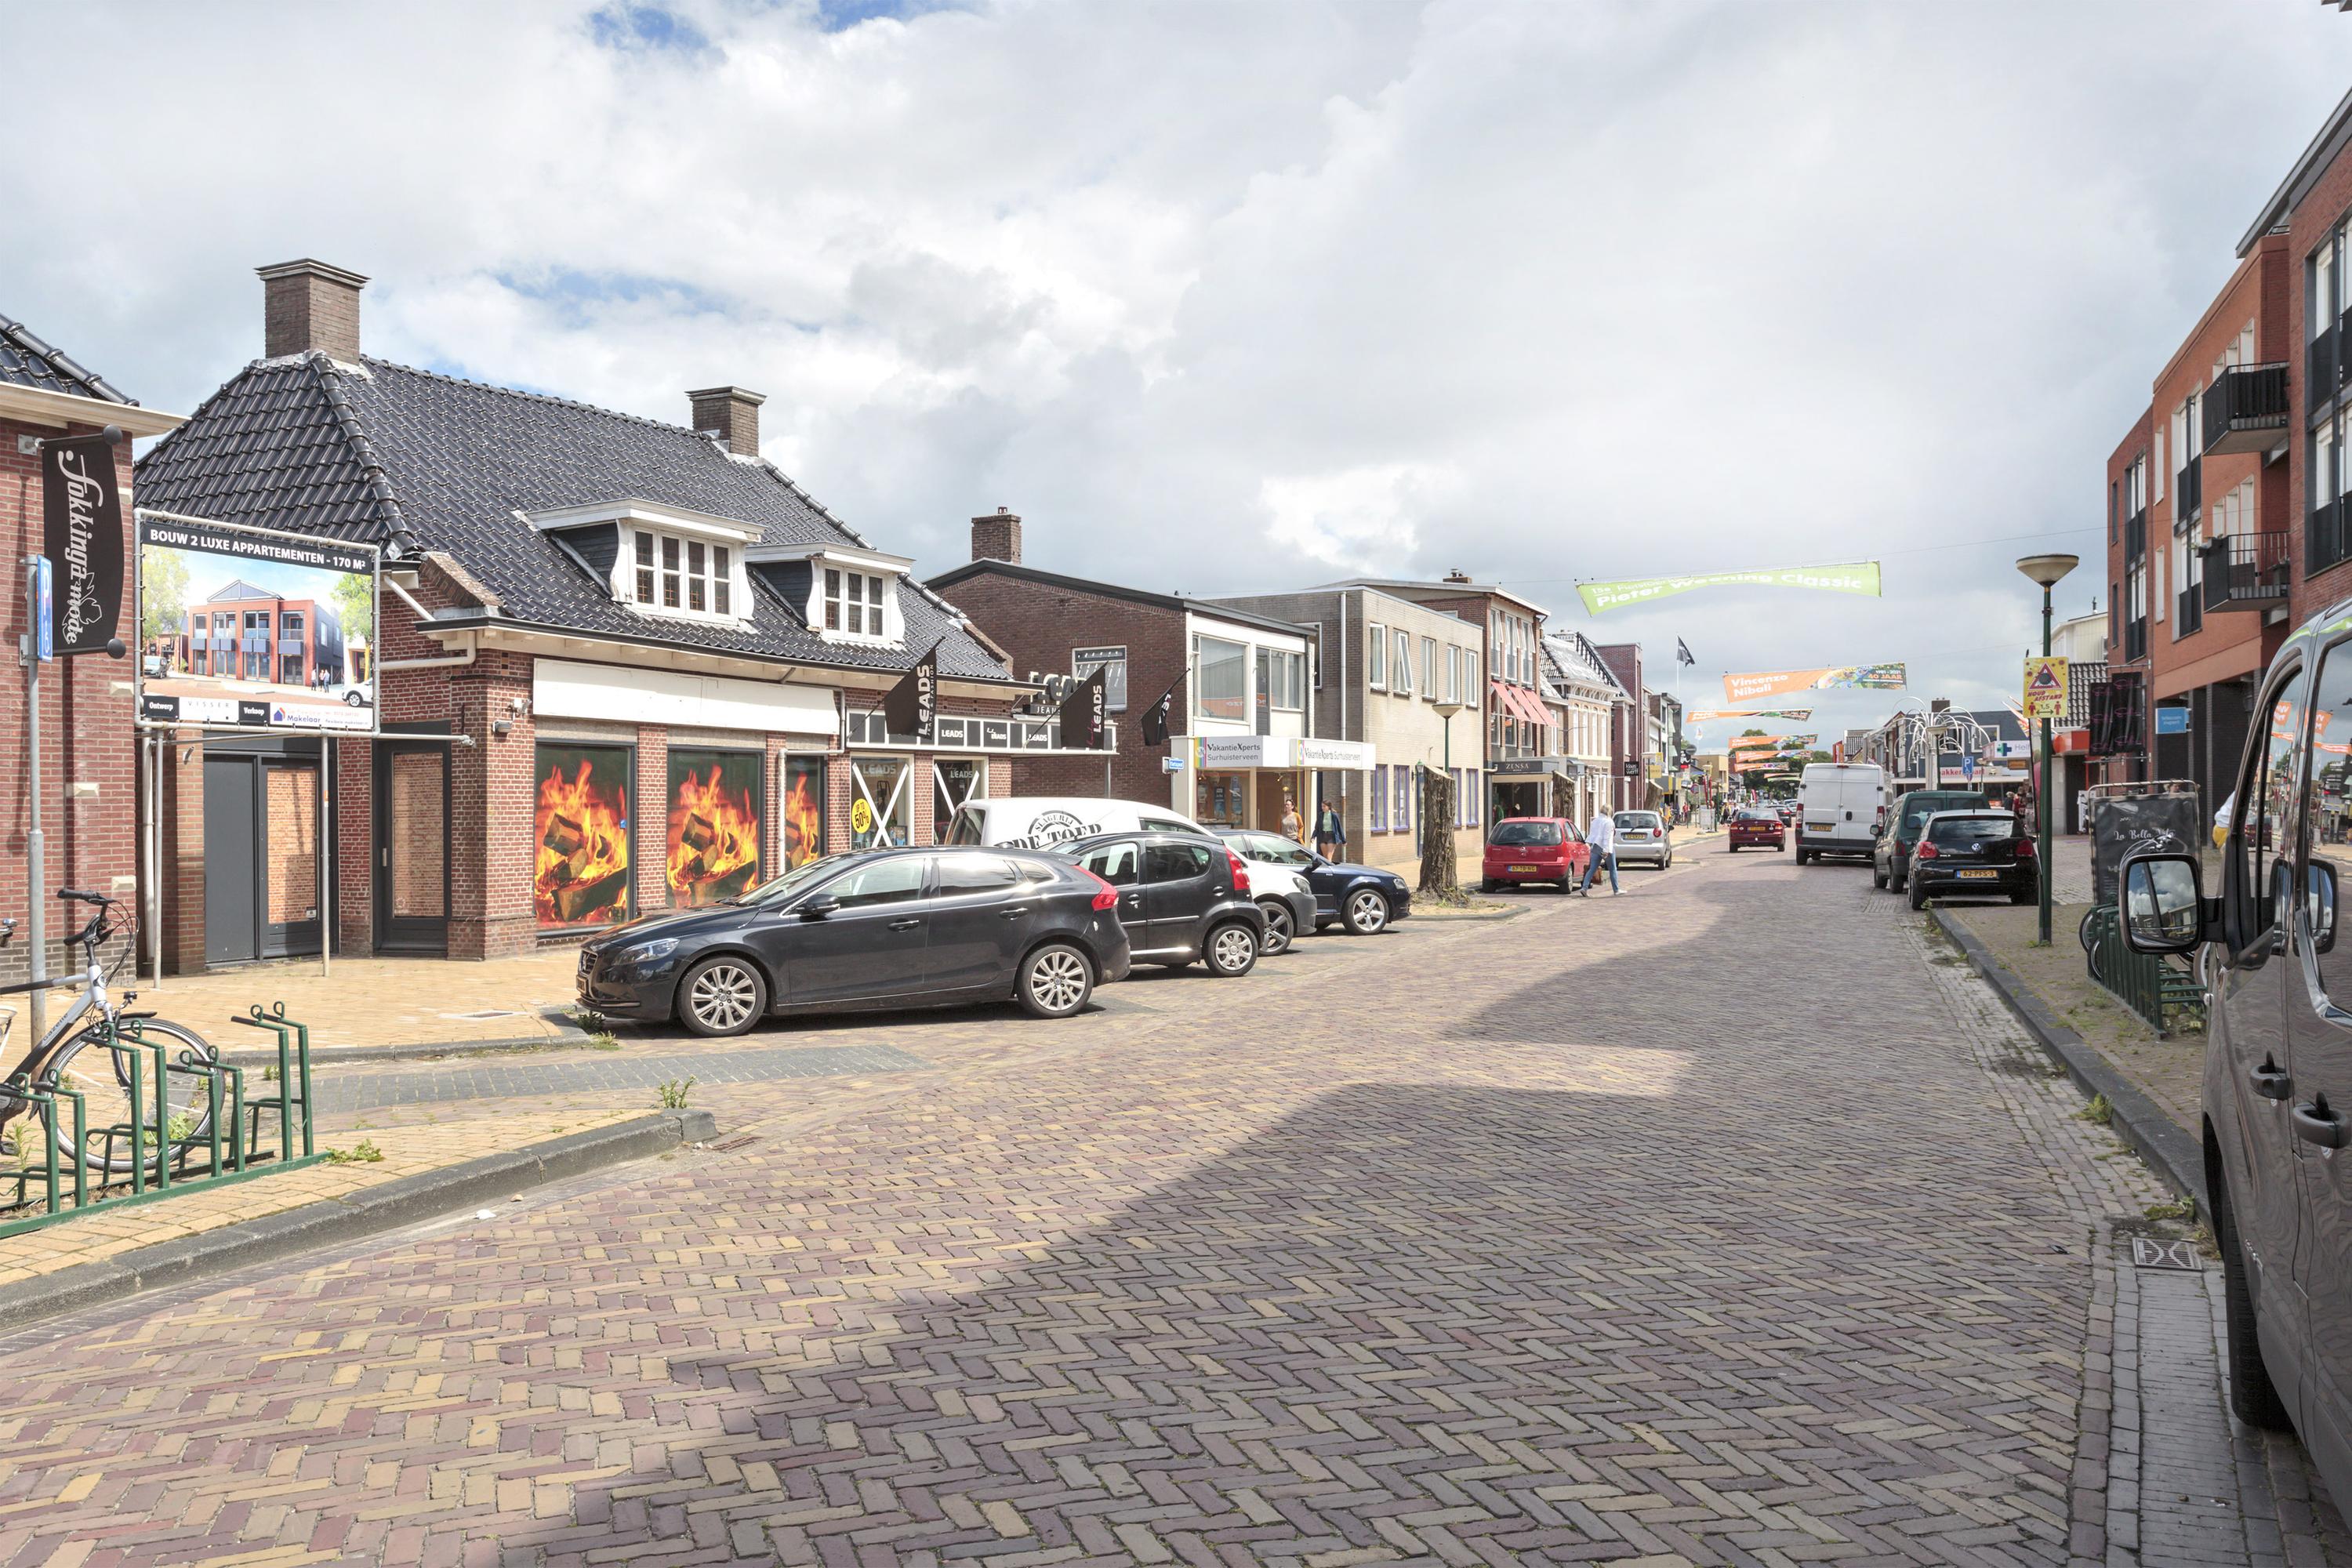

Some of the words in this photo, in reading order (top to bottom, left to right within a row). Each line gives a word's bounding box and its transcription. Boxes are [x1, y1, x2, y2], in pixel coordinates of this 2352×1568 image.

[150, 528, 188, 546] BOUW
[190, 535, 198, 546] 2
[201, 538, 230, 551] LUXE
[232, 541, 325, 565] APPARTEMENTEN
[332, 557, 351, 568] 170
[1596, 586, 1663, 608] Pieter
[1669, 573, 1773, 589] Weening
[1780, 574, 1863, 589] Classic
[1731, 674, 1788, 688] Vincenzo
[1733, 681, 1772, 698] Nibali
[916, 665, 931, 735] LEADS
[149, 702, 173, 711] Ontwerp
[243, 707, 265, 717] Verkoop
[287, 714, 321, 724] Makelaar
[1093, 684, 1102, 733] LEADS
[941, 729, 964, 738] LEADS
[1207, 742, 1261, 752] VakantieXperts
[862, 764, 897, 775] LEADS
[1964, 758, 1971, 768] P
[949, 770, 973, 779] LEADS
[855, 804, 860, 813] UP
[855, 811, 869, 829] 50%
[1035, 815, 1074, 831] SLAGERIJ
[2129, 829, 2152, 840] Bella
